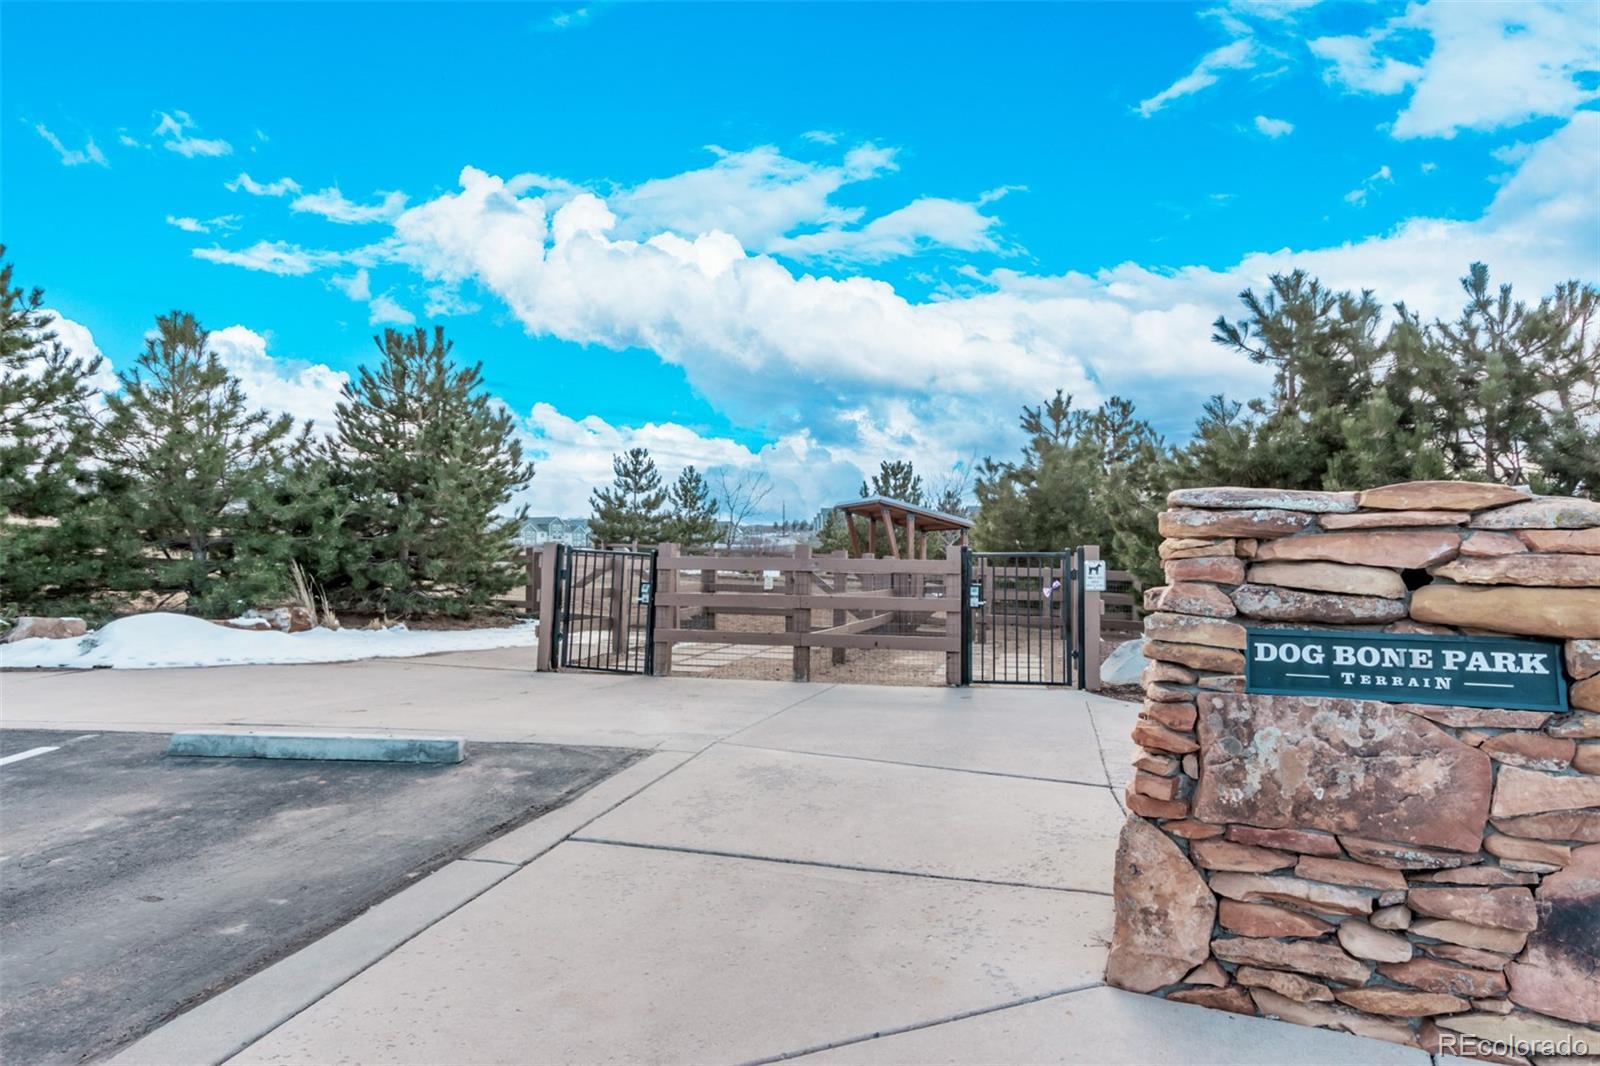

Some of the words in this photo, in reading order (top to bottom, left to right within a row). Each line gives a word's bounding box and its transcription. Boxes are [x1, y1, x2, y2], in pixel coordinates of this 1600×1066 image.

[1254, 642, 1325, 665] DOG
[1332, 645, 1433, 669] BONE
[1442, 650, 1550, 675] PARK
[1341, 672, 1452, 690] TERRAIN
